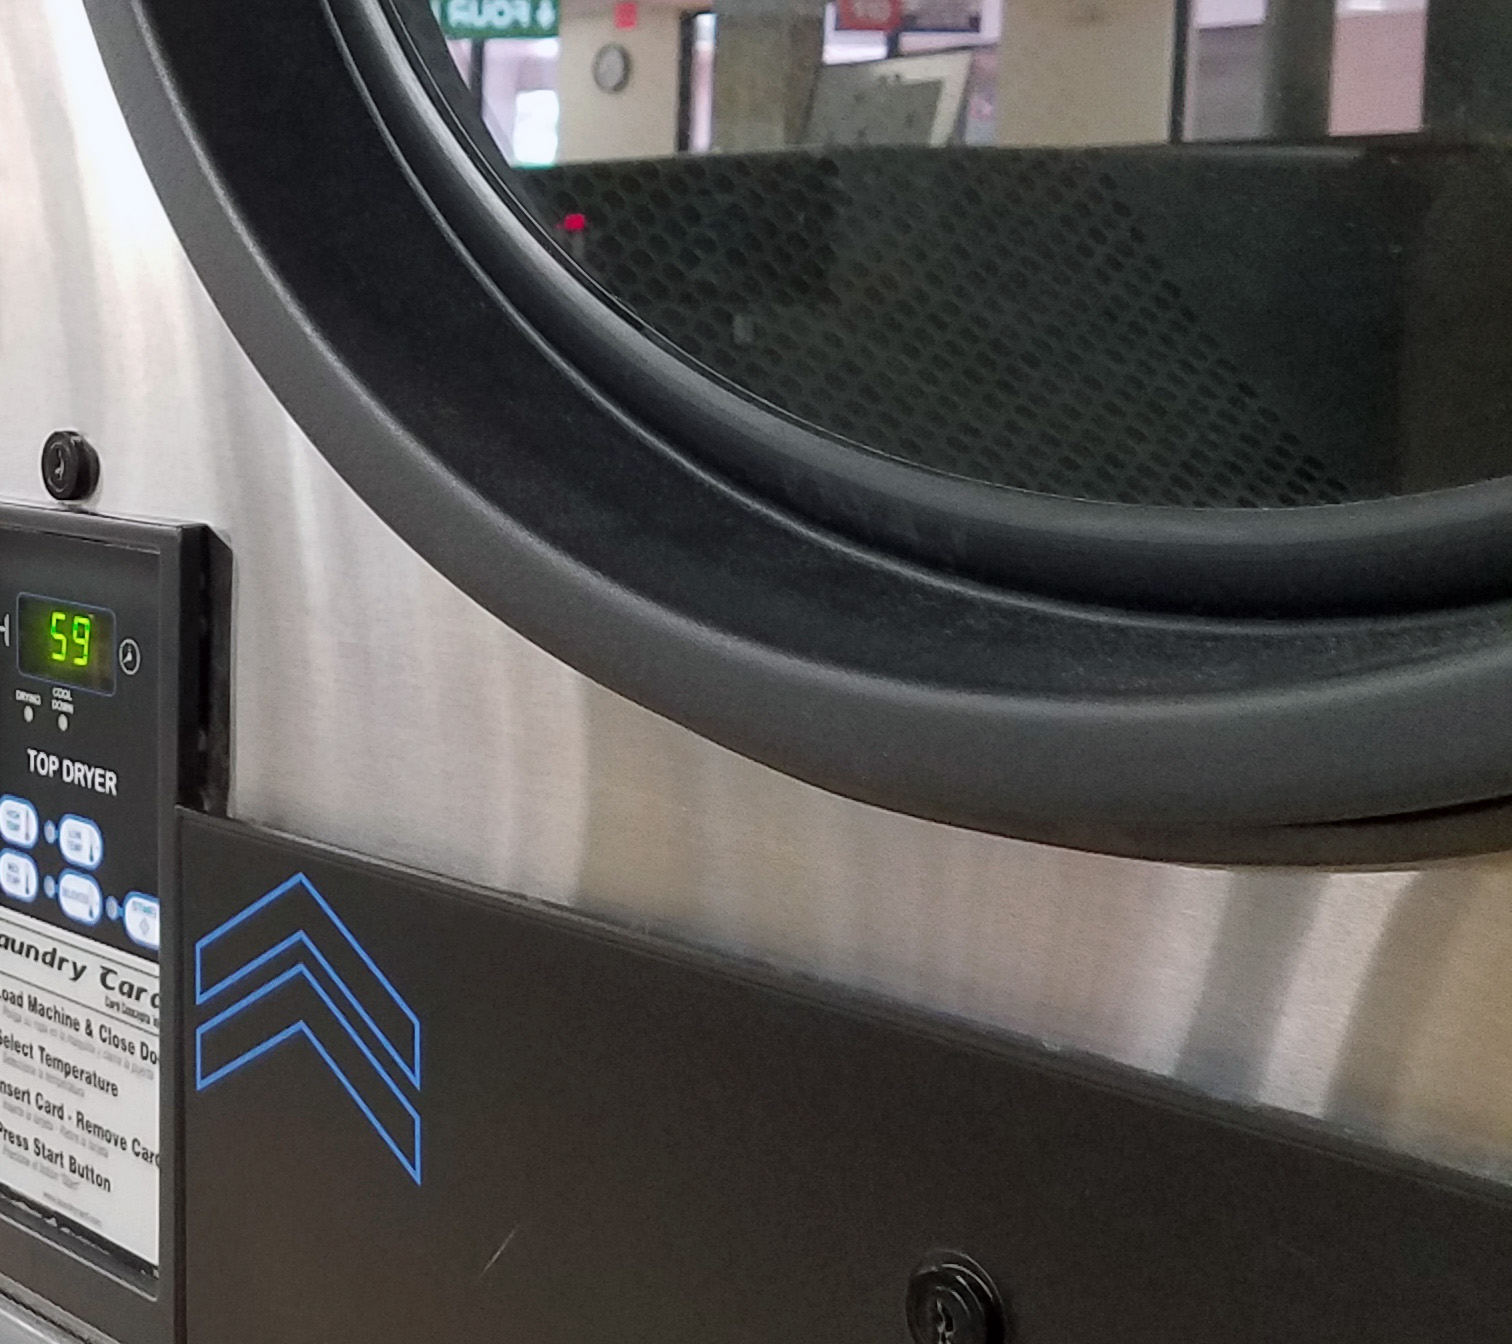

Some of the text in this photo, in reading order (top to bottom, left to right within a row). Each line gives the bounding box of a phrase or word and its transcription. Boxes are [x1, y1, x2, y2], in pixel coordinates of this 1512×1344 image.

[50, 612, 91, 666] 59
[27, 747, 118, 797] TOP DRYER
[27, 993, 81, 1033] Machine
[84, 1018, 94, 1039] &
[98, 1022, 136, 1056] Close
[140, 1040, 160, 1066] Do
[38, 1044, 119, 1098] Temperature
[35, 1091, 65, 1121] Card
[75, 1110, 128, 1152] Remove
[33, 1137, 65, 1169] Start
[68, 1154, 112, 1193] Button
